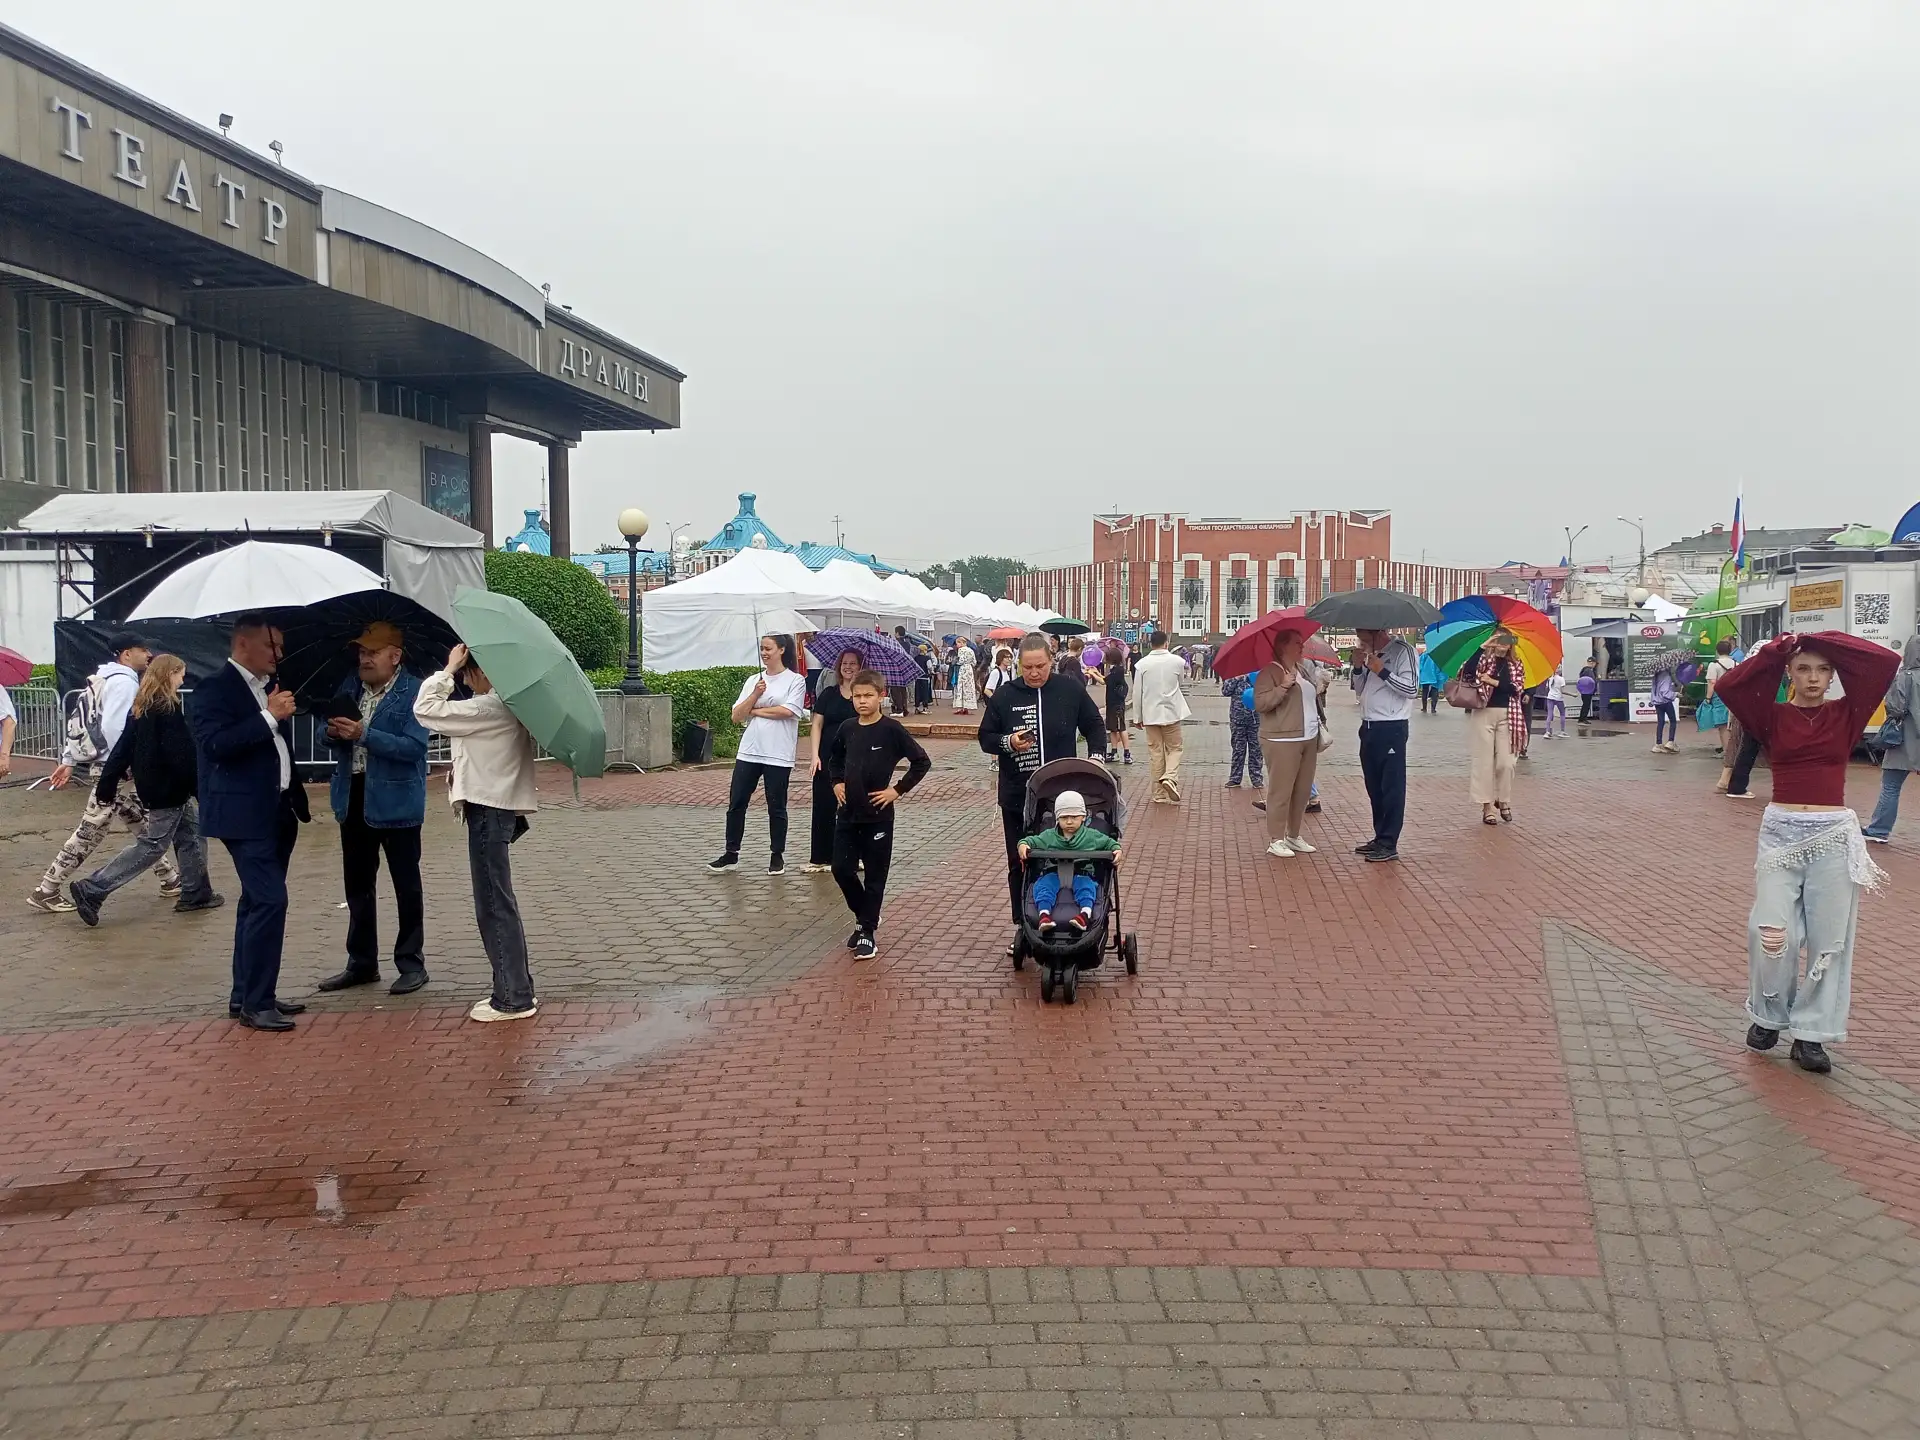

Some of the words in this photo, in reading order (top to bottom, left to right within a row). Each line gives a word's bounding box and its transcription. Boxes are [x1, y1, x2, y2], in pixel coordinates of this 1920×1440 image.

[52, 95, 288, 246] ТЕАТР
[560, 338, 649, 403] ДРАМЫ
[1643, 627, 1662, 636] SAVA
